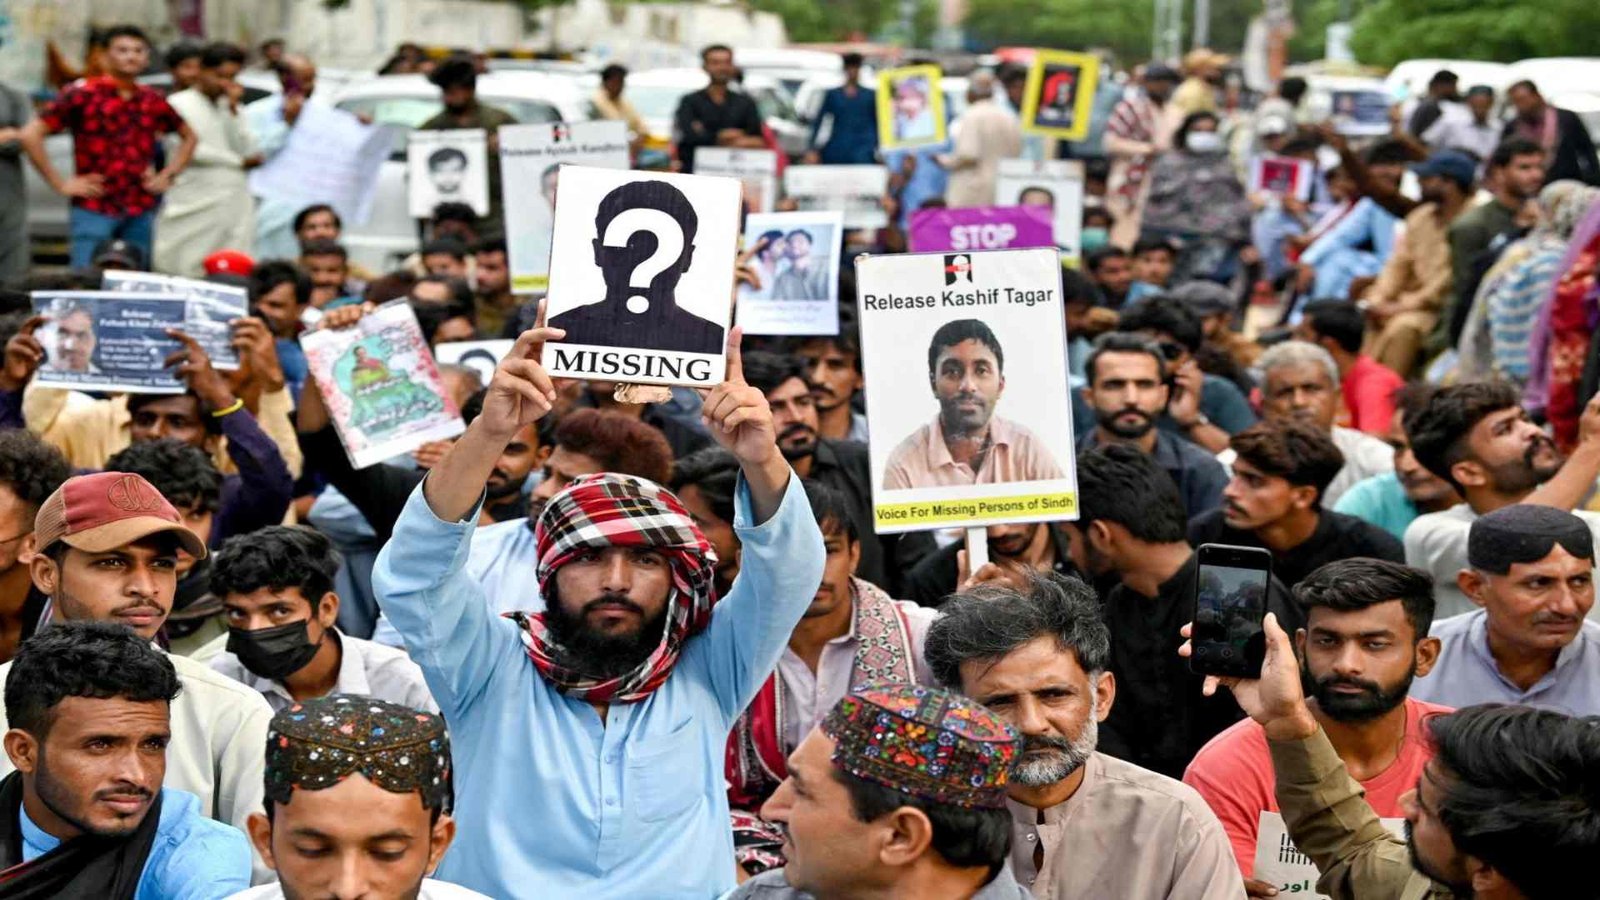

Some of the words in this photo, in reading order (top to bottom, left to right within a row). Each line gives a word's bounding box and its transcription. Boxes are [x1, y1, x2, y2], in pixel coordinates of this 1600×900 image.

[950, 223, 1017, 250] STOP
[864, 293, 936, 311] Release
[941, 288, 1000, 307] Kashif
[1004, 287, 1054, 307] Tagar
[552, 348, 712, 382] MISSING
[876, 507, 907, 521] Voice
[911, 506, 929, 518] For
[932, 503, 976, 517] Missing
[979, 501, 1024, 514] Persons
[1027, 499, 1039, 511] of
[1041, 497, 1074, 509] Sindh
[1279, 879, 1309, 893] اور
